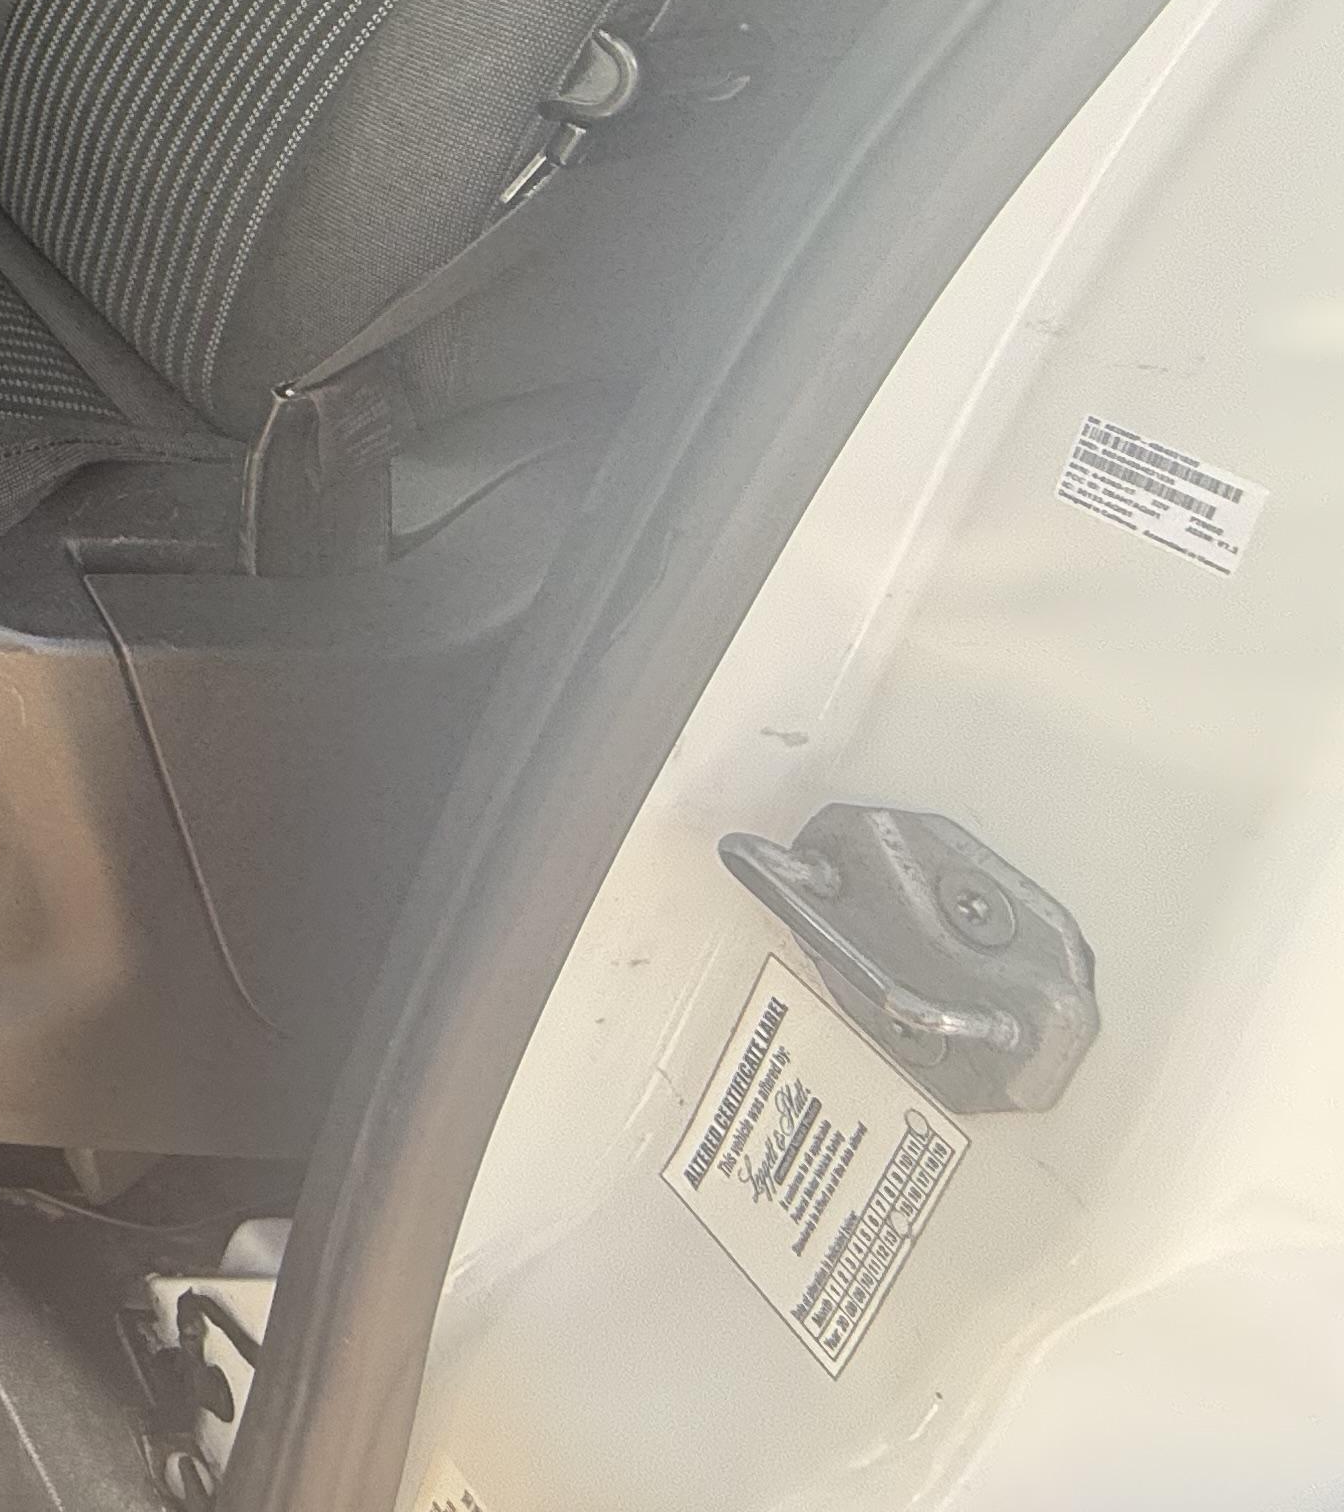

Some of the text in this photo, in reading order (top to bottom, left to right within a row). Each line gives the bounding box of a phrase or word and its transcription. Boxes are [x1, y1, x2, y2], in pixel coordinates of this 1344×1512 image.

[683, 995, 789, 1191] ALTERED CERTIFICATE LABEL
[716, 1152, 738, 1179] This
[729, 1117, 755, 1158] vehicle
[746, 1096, 765, 1123] was
[757, 1058, 783, 1103] altered
